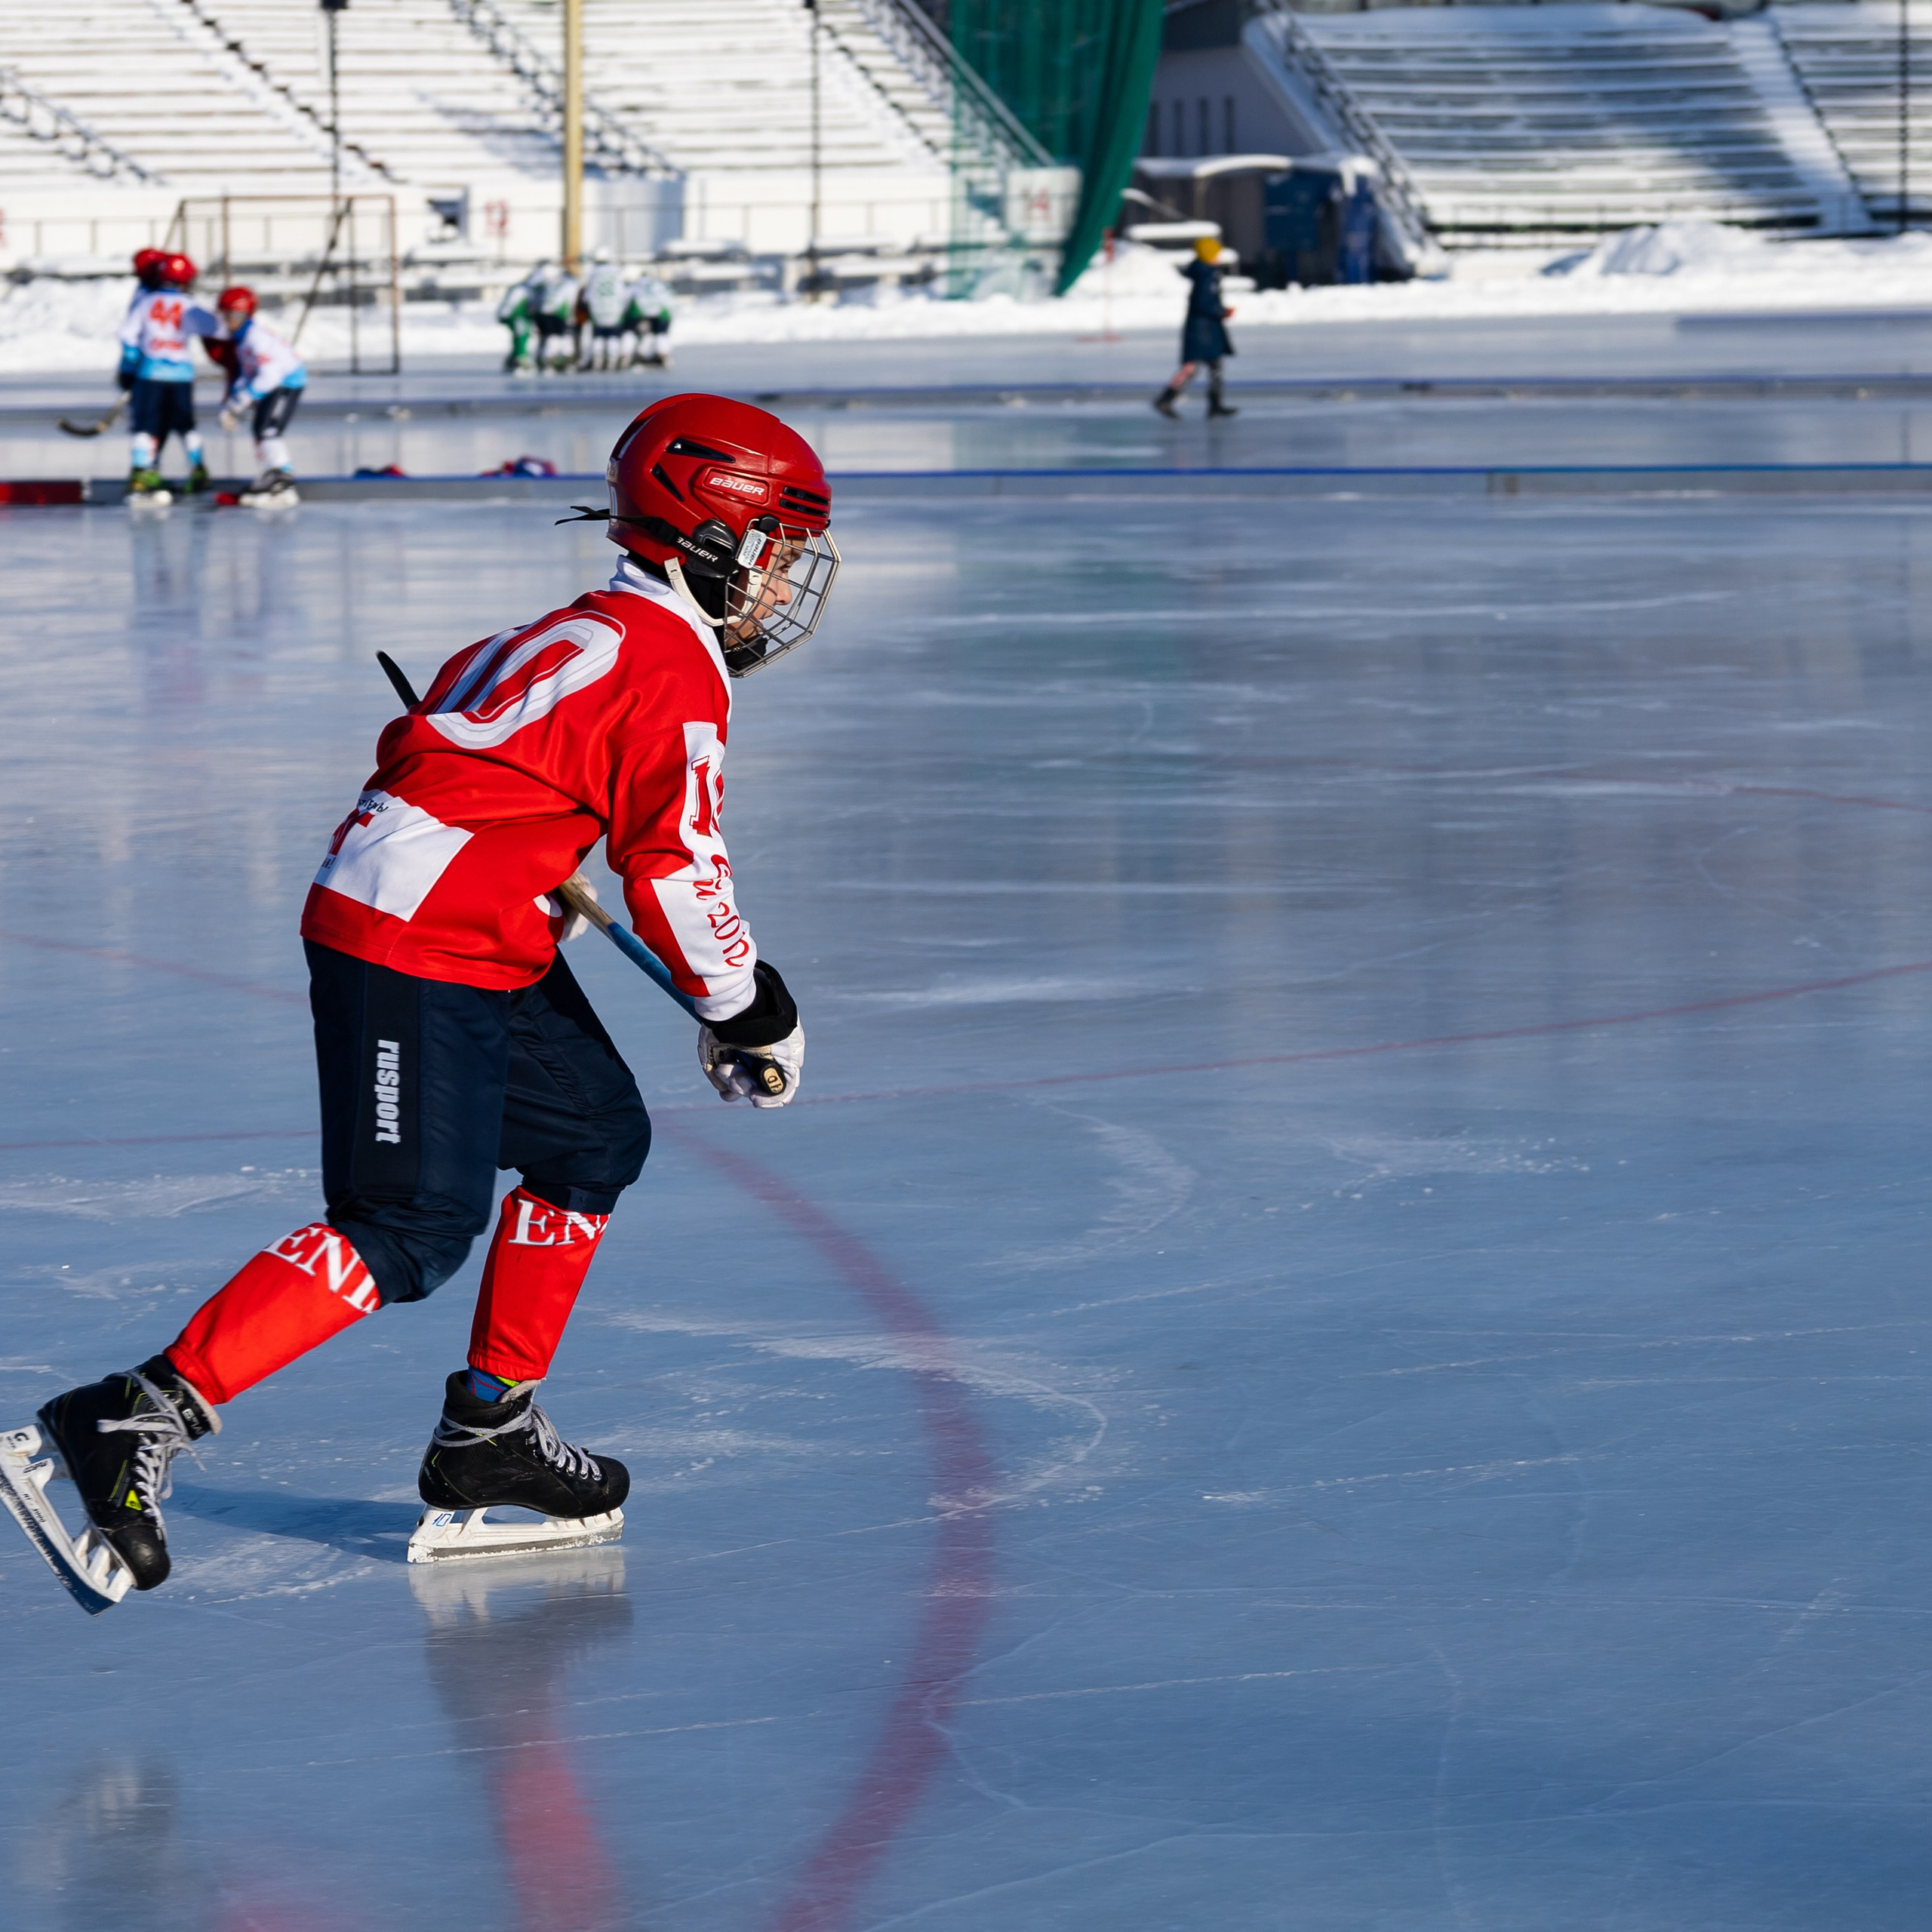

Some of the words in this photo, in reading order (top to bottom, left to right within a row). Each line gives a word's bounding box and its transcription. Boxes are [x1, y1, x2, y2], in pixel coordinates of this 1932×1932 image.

[709, 476, 765, 496] BAUER
[374, 1039, 401, 1144] rusport
[507, 1198, 611, 1246] EN
